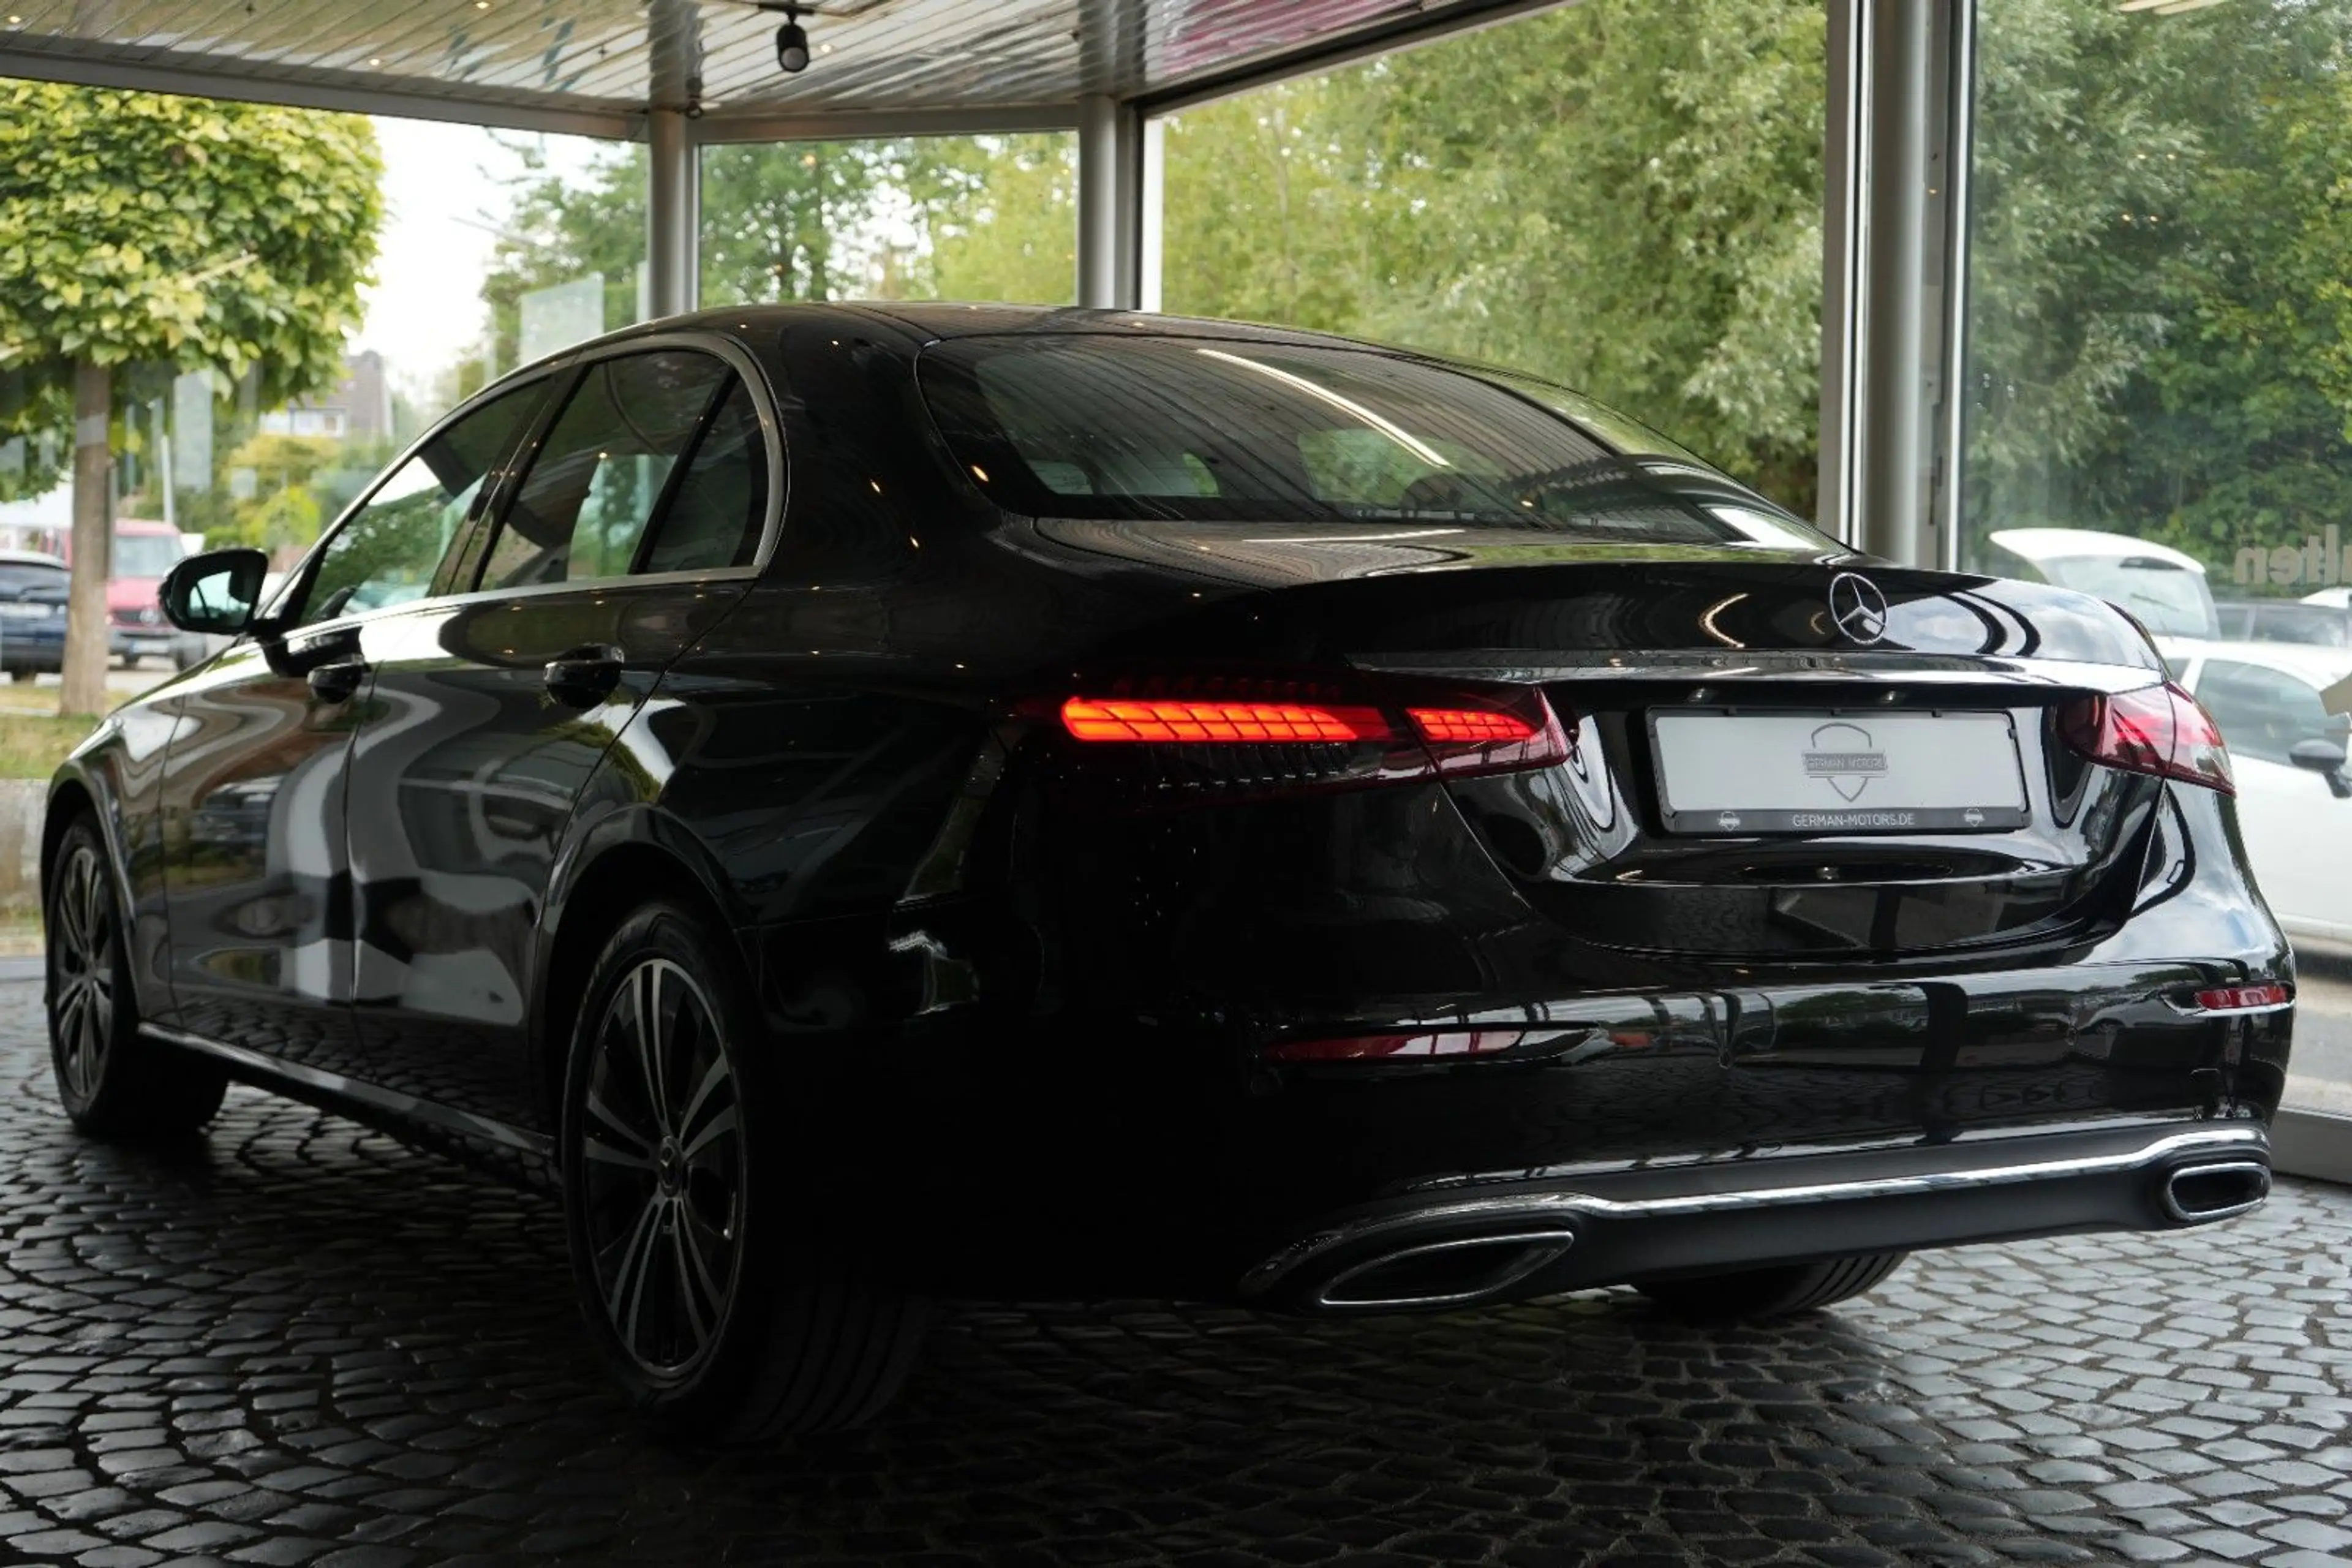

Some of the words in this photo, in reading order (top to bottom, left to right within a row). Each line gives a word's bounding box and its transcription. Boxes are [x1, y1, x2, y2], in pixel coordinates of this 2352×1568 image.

[1806, 756, 1845, 769] GERMAN
[1848, 755, 1885, 769] MOTORS
[1793, 813, 1915, 827] GERMAN-MOTORS.DE
